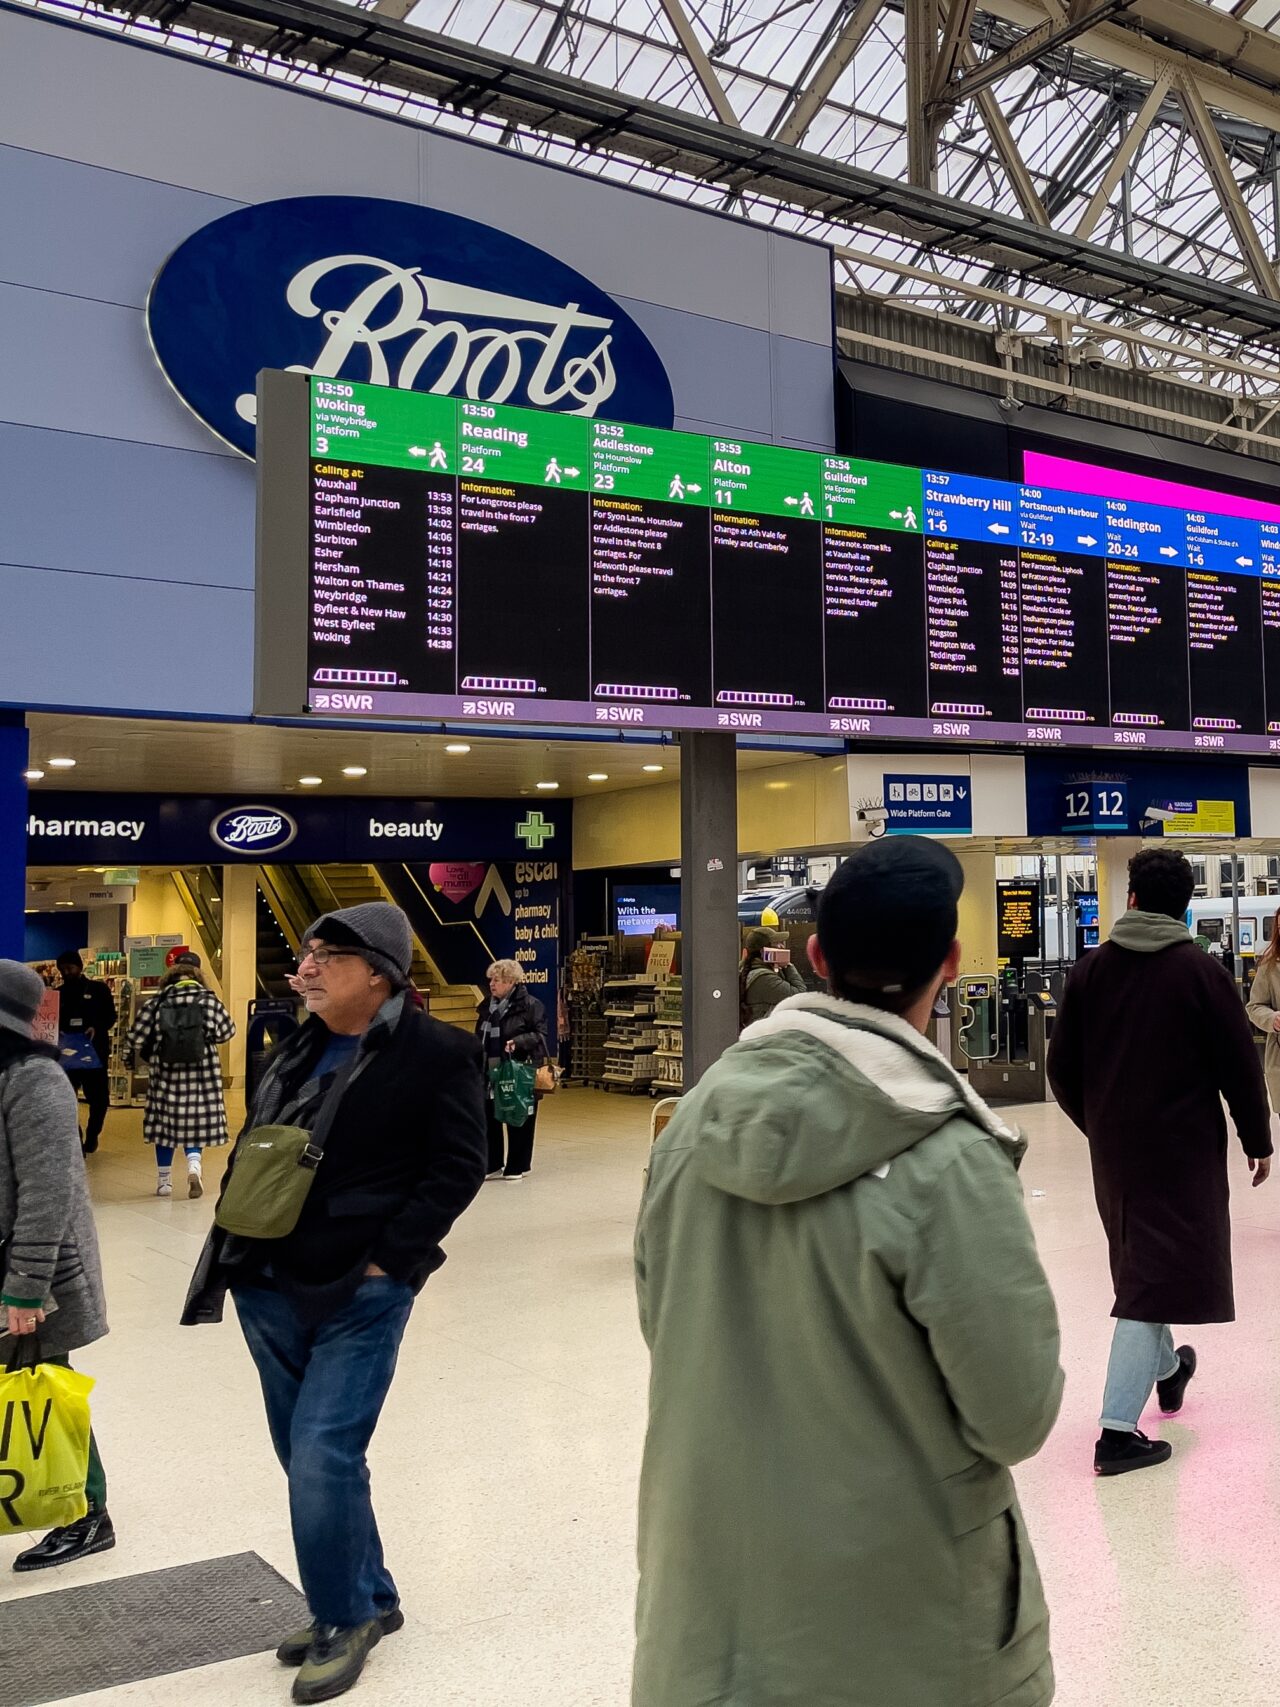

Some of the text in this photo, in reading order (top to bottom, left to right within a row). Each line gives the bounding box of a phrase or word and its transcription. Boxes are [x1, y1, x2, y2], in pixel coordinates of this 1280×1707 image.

[236, 254, 617, 424] Boots
[316, 382, 353, 398] 13:50
[315, 397, 366, 417] Woking
[462, 403, 496, 419] 13:50
[315, 412, 377, 429] via Weybridge
[315, 424, 360, 439] Platform
[462, 422, 529, 448] Reading
[593, 423, 625, 437] 13:52
[316, 437, 329, 454] 3
[462, 443, 502, 458] Platform
[593, 437, 654, 456] Addlestone
[714, 441, 742, 455] 13:53
[462, 456, 485, 474] 24
[593, 452, 643, 466] via Hounslow
[824, 458, 850, 472] 13:54
[314, 464, 364, 479] Calling at:
[593, 461, 630, 475] Platform
[714, 459, 751, 476] Alton
[314, 478, 357, 492] Vauxhall
[594, 473, 615, 490] 23
[714, 478, 748, 491] Platform
[824, 471, 868, 487] Guildford
[926, 474, 950, 486] 13:57
[427, 490, 453, 502] 13:53
[715, 489, 732, 505] 11
[824, 484, 856, 496] via Epsom
[1020, 487, 1042, 500] 14:00
[314, 491, 401, 511] Clapham Junction
[824, 493, 856, 505] Platform
[926, 489, 1012, 513] Strawberry Hill
[1106, 500, 1127, 512] 14:00
[314, 505, 361, 520] Earlsfield
[825, 504, 834, 519] 1
[926, 507, 944, 518] Wait
[1020, 499, 1099, 520] Portsmouth Harbour
[927, 518, 948, 533] 1-6
[1021, 520, 1037, 531] Wait
[1106, 515, 1162, 534] Teddington
[1186, 513, 1206, 525] 14:03
[314, 519, 372, 535] Wimbledon
[1186, 524, 1219, 537] Guildford
[1260, 524, 1279, 535] 14:03
[314, 533, 358, 547] Surbiton
[1022, 530, 1055, 546] 12-19
[1107, 532, 1122, 542] Wait
[314, 547, 343, 560] Esher
[1107, 543, 1139, 558] 20-24
[1187, 543, 1201, 553] Wait
[1188, 552, 1205, 566] 1-6
[1261, 553, 1275, 563] Wait
[314, 561, 360, 575] Hersham
[314, 575, 405, 593] Walton on Thames
[314, 589, 368, 604] Weybridge
[313, 630, 352, 645] Woking
[331, 693, 374, 711] SWR
[477, 701, 515, 717] SWR
[609, 707, 644, 723] SWR
[729, 713, 762, 727] SWR
[841, 718, 871, 732] SWR
[943, 723, 971, 736] SWR
[1036, 728, 1062, 740] SWR
[1122, 731, 1146, 744] SWR
[1203, 735, 1225, 747] SWR
[1065, 791, 1090, 818] 12
[1097, 791, 1124, 816] 12
[890, 808, 951, 819] Wide Platform Gate
[26, 815, 146, 841] harmacy
[223, 815, 283, 843] Boots
[369, 818, 444, 841] beauty
[446, 865, 465, 874] Love
[457, 871, 469, 880] all
[89, 890, 114, 899] men's
[515, 887, 529, 899] up to
[1078, 899, 1091, 907] Find
[515, 904, 552, 921] pharmacy
[617, 906, 656, 915] With the
[617, 917, 667, 926] metaverse.
[515, 923, 559, 943] baby & child
[515, 947, 537, 963] photo
[650, 958, 670, 967] PRICES
